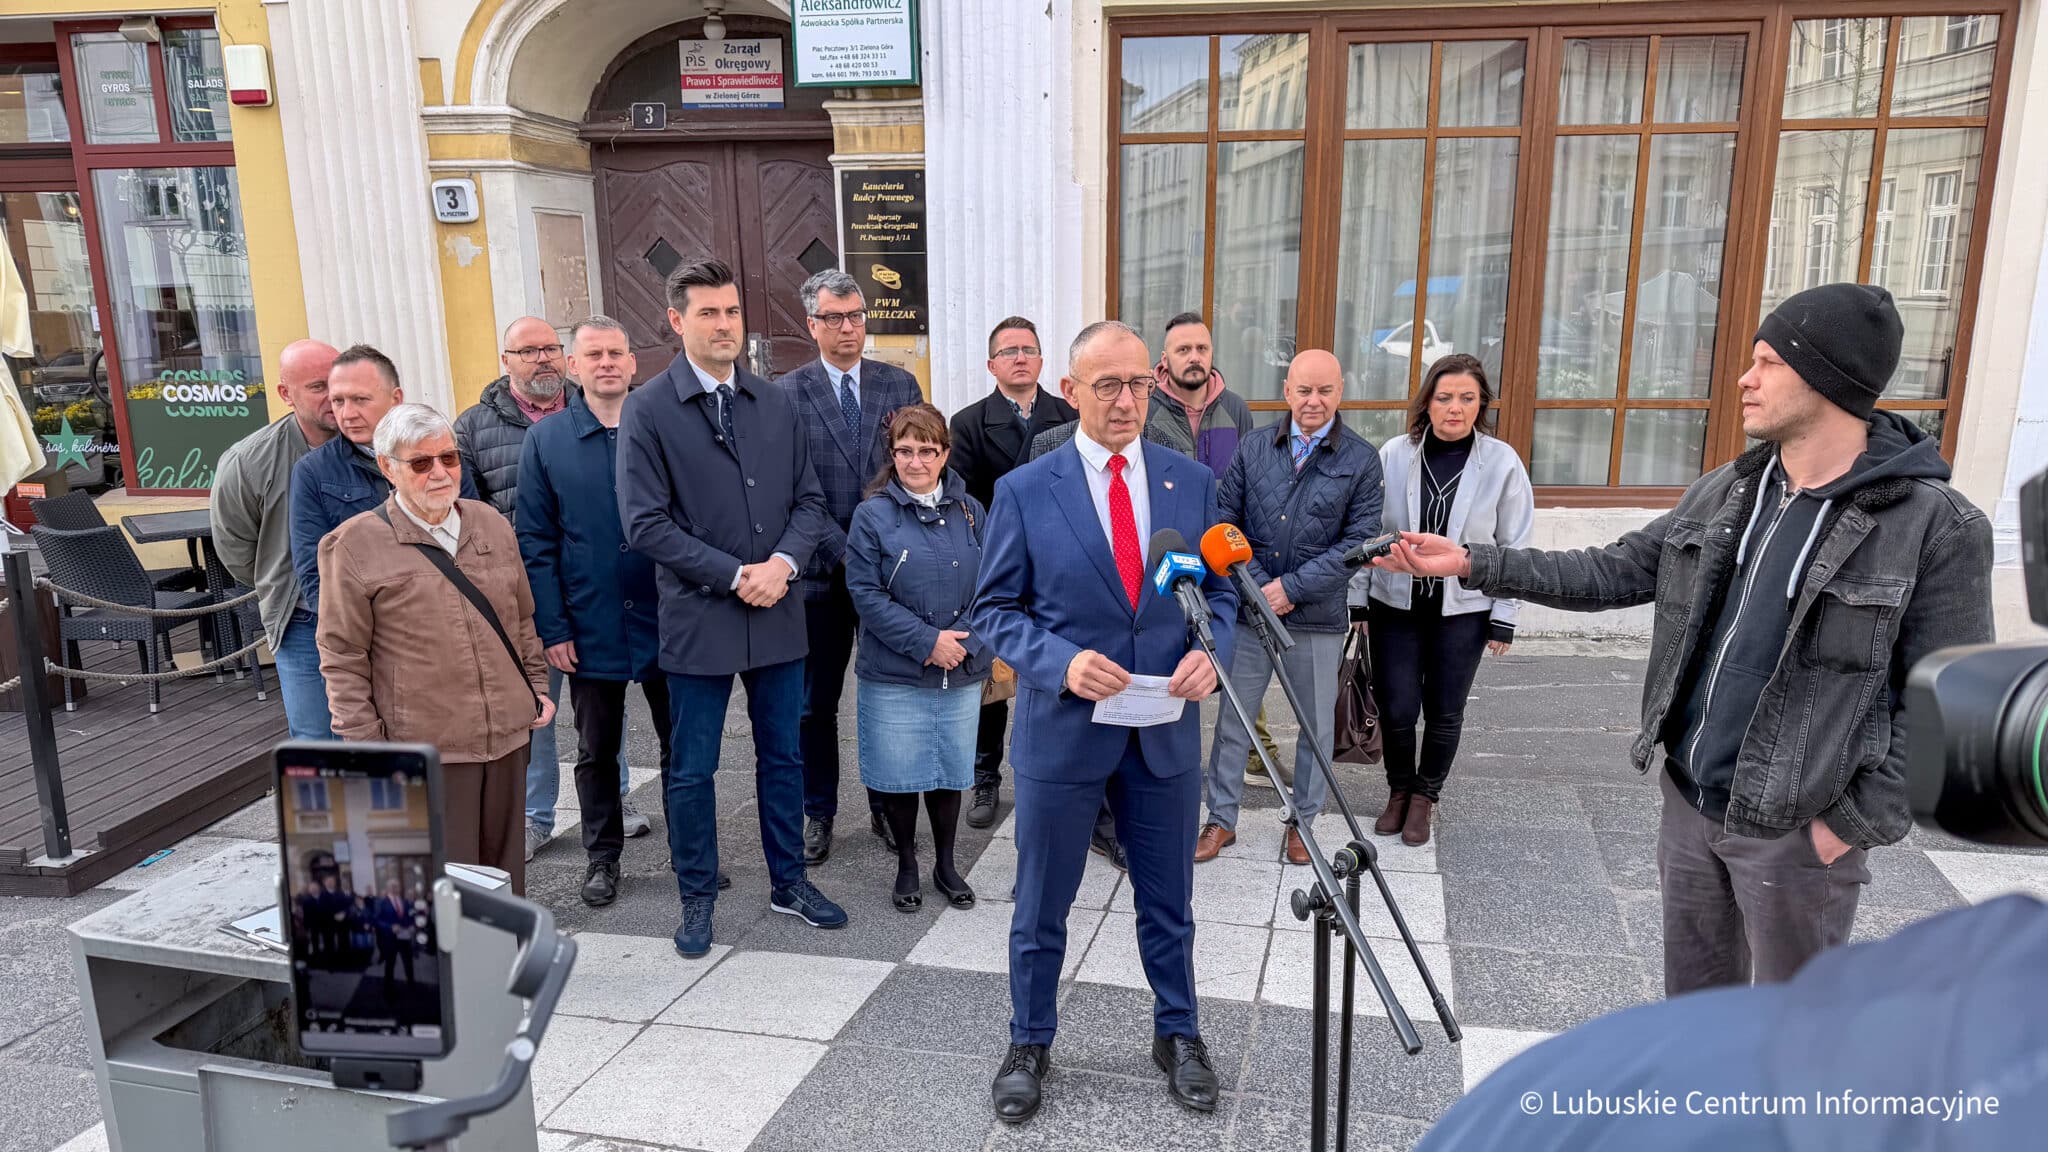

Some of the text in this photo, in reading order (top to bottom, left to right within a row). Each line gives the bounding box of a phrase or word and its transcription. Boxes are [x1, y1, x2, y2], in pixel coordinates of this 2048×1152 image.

[801, 0, 901, 11] Aleksandrowicz
[801, 17, 903, 27] Adwokacka Spółka Partnerska
[724, 42, 761, 56] Zarząd
[715, 58, 771, 71] Okręgowy
[188, 79, 224, 89] SALADS
[686, 74, 779, 88] Prawo i Sprawiedliwość
[101, 84, 130, 93] GYROS
[713, 92, 740, 100] Zielonej
[741, 91, 760, 99] Górze
[645, 106, 653, 124] 3
[862, 182, 905, 191] Kancelaria
[446, 188, 459, 209] 3
[852, 193, 915, 203] Radcy Prawnego
[875, 298, 901, 308] PWM
[162, 384, 248, 402] COSMOS
